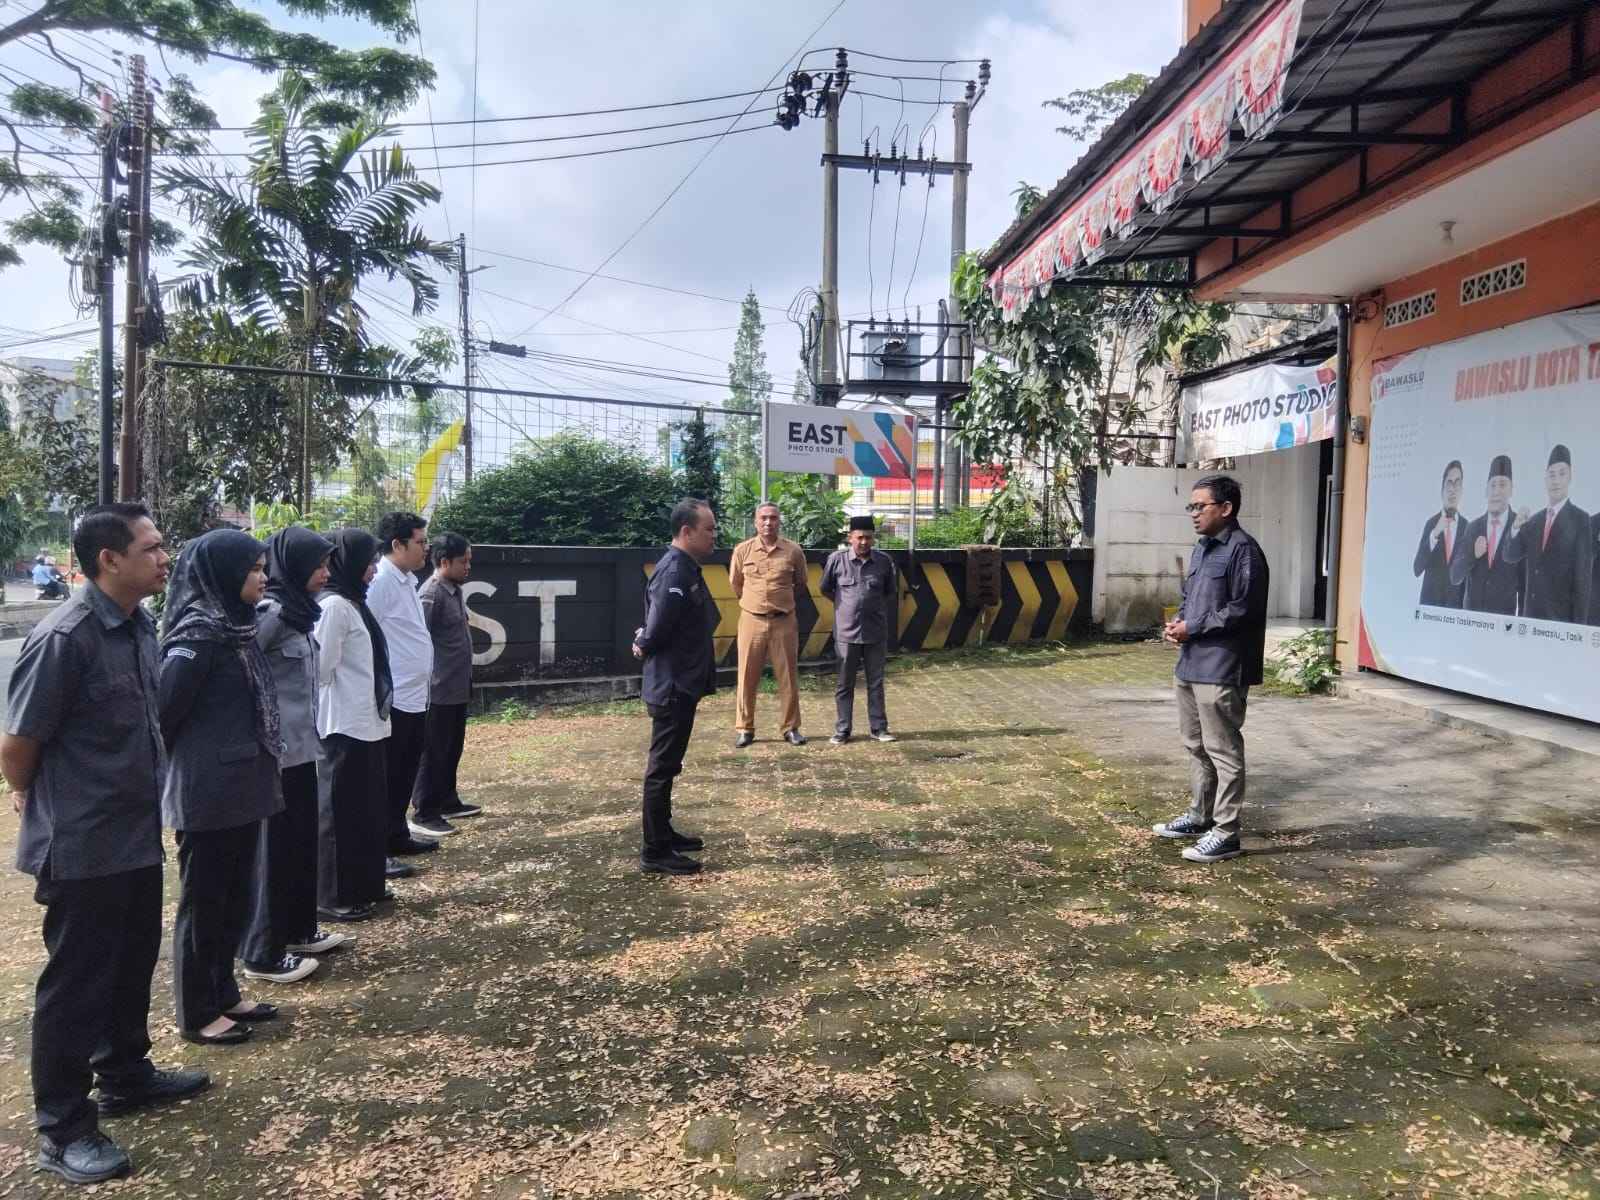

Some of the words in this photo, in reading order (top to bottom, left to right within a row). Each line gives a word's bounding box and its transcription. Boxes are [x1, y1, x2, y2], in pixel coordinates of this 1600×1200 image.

[1456, 355, 1531, 401] BAWASLU
[1535, 344, 1582, 388] KOTA
[1191, 407, 1221, 432] EAST
[1222, 396, 1270, 428] PHOTO
[1273, 382, 1337, 418] STUDIO
[788, 422, 847, 446] EAST
[788, 444, 814, 453] PHOTO
[815, 446, 842, 455] STUDIO
